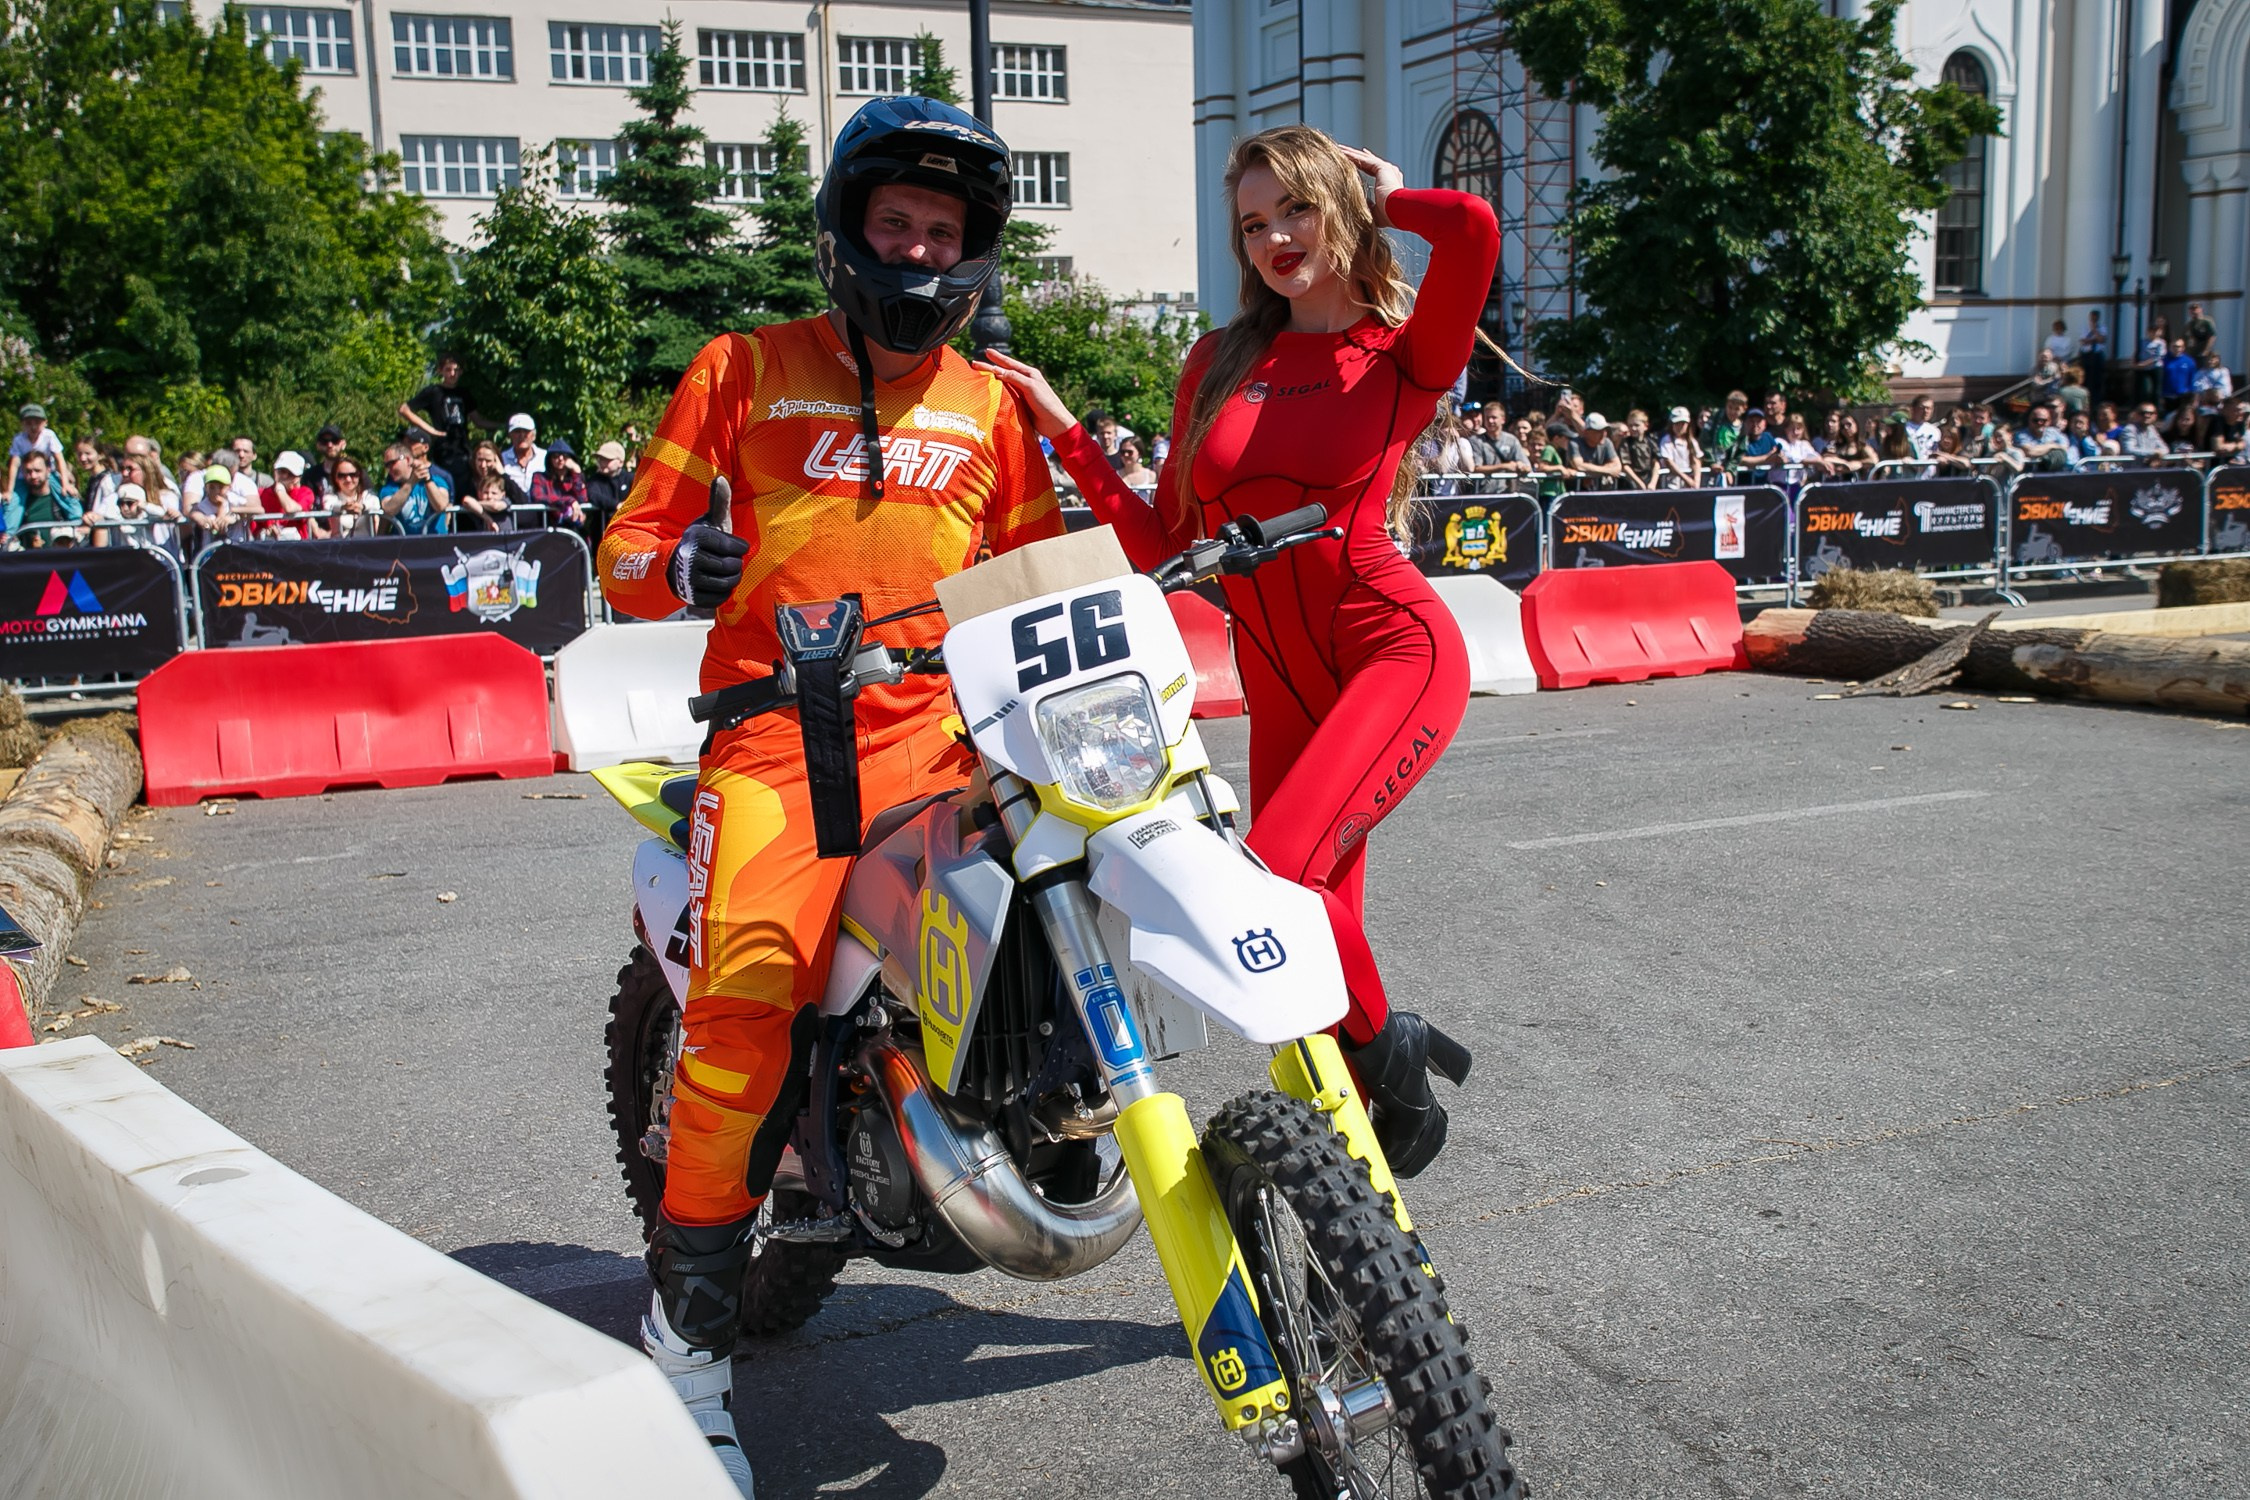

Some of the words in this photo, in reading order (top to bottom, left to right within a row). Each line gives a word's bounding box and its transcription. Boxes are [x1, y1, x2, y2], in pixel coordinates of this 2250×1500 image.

[1277, 380, 1332, 397] SEGAL
[803, 430, 973, 492] LEATT
[216, 571, 274, 581] ФЕСТИВАЛЬ
[373, 577, 400, 587] УРАЛ
[1011, 589, 1131, 693] 56
[1373, 724, 1440, 812] SEGAL
[850, 1168, 891, 1186] REKLUSE
